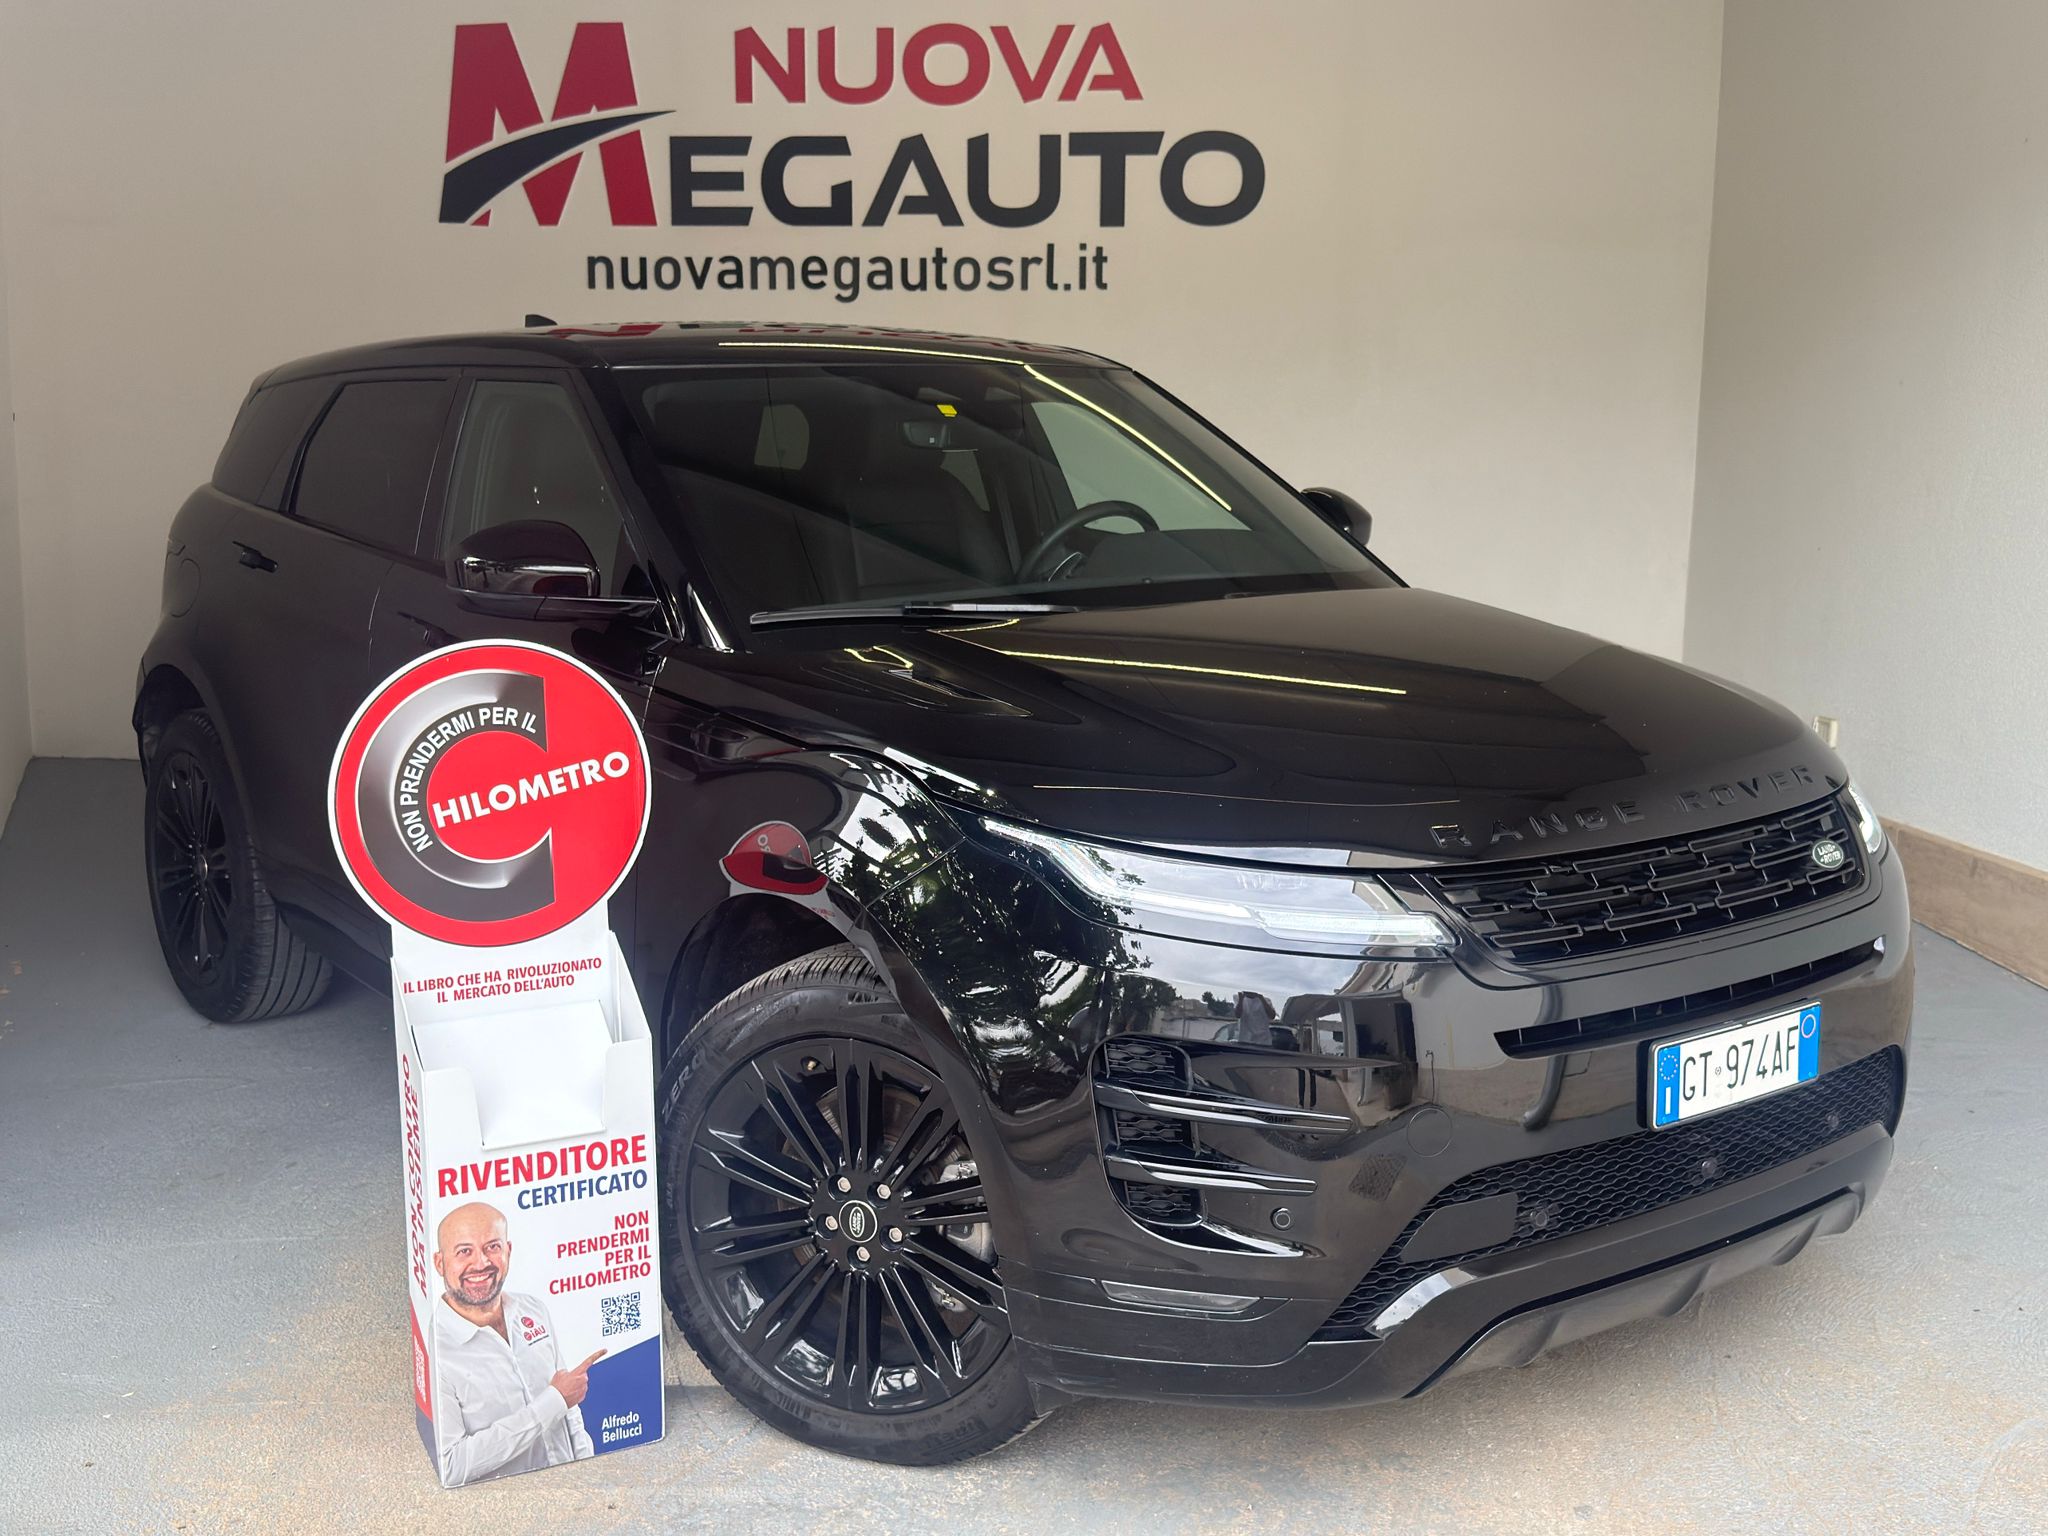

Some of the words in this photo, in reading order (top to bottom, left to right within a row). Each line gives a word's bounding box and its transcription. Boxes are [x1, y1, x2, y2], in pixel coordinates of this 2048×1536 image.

[734, 22, 1143, 106] NUOVA
[586, 243, 1109, 304] nuovamegautosrl.it
[479, 706, 518, 727] PER
[521, 712, 536, 734] IL
[400, 714, 475, 806] PRENDERMI
[1429, 801, 1646, 848] RANGE
[1675, 764, 1814, 816] ROVER
[402, 809, 433, 853] NON
[403, 981, 415, 994] IL
[417, 976, 454, 992] LIBRO
[457, 972, 482, 987] CHE
[484, 970, 501, 983] HA
[507, 957, 602, 980] RIVOLUZIONATO
[437, 991, 448, 1003] IL
[454, 983, 511, 1002] MERCATO
[514, 974, 575, 993] DELL'AUTO
[1682, 1050, 1713, 1102] GT
[1726, 1025, 1799, 1089] 974AF
[438, 1134, 648, 1198] RIVENDITORE
[517, 1169, 649, 1210] CERTIFICATO
[614, 1210, 650, 1230] NON
[557, 1227, 650, 1259] PRENDERMI
[604, 1246, 635, 1268] PER
[637, 1243, 652, 1260] IL
[549, 1262, 652, 1295] CHILOMETRO
[602, 1411, 640, 1431] Alfredo
[602, 1424, 643, 1444] Bellucci
